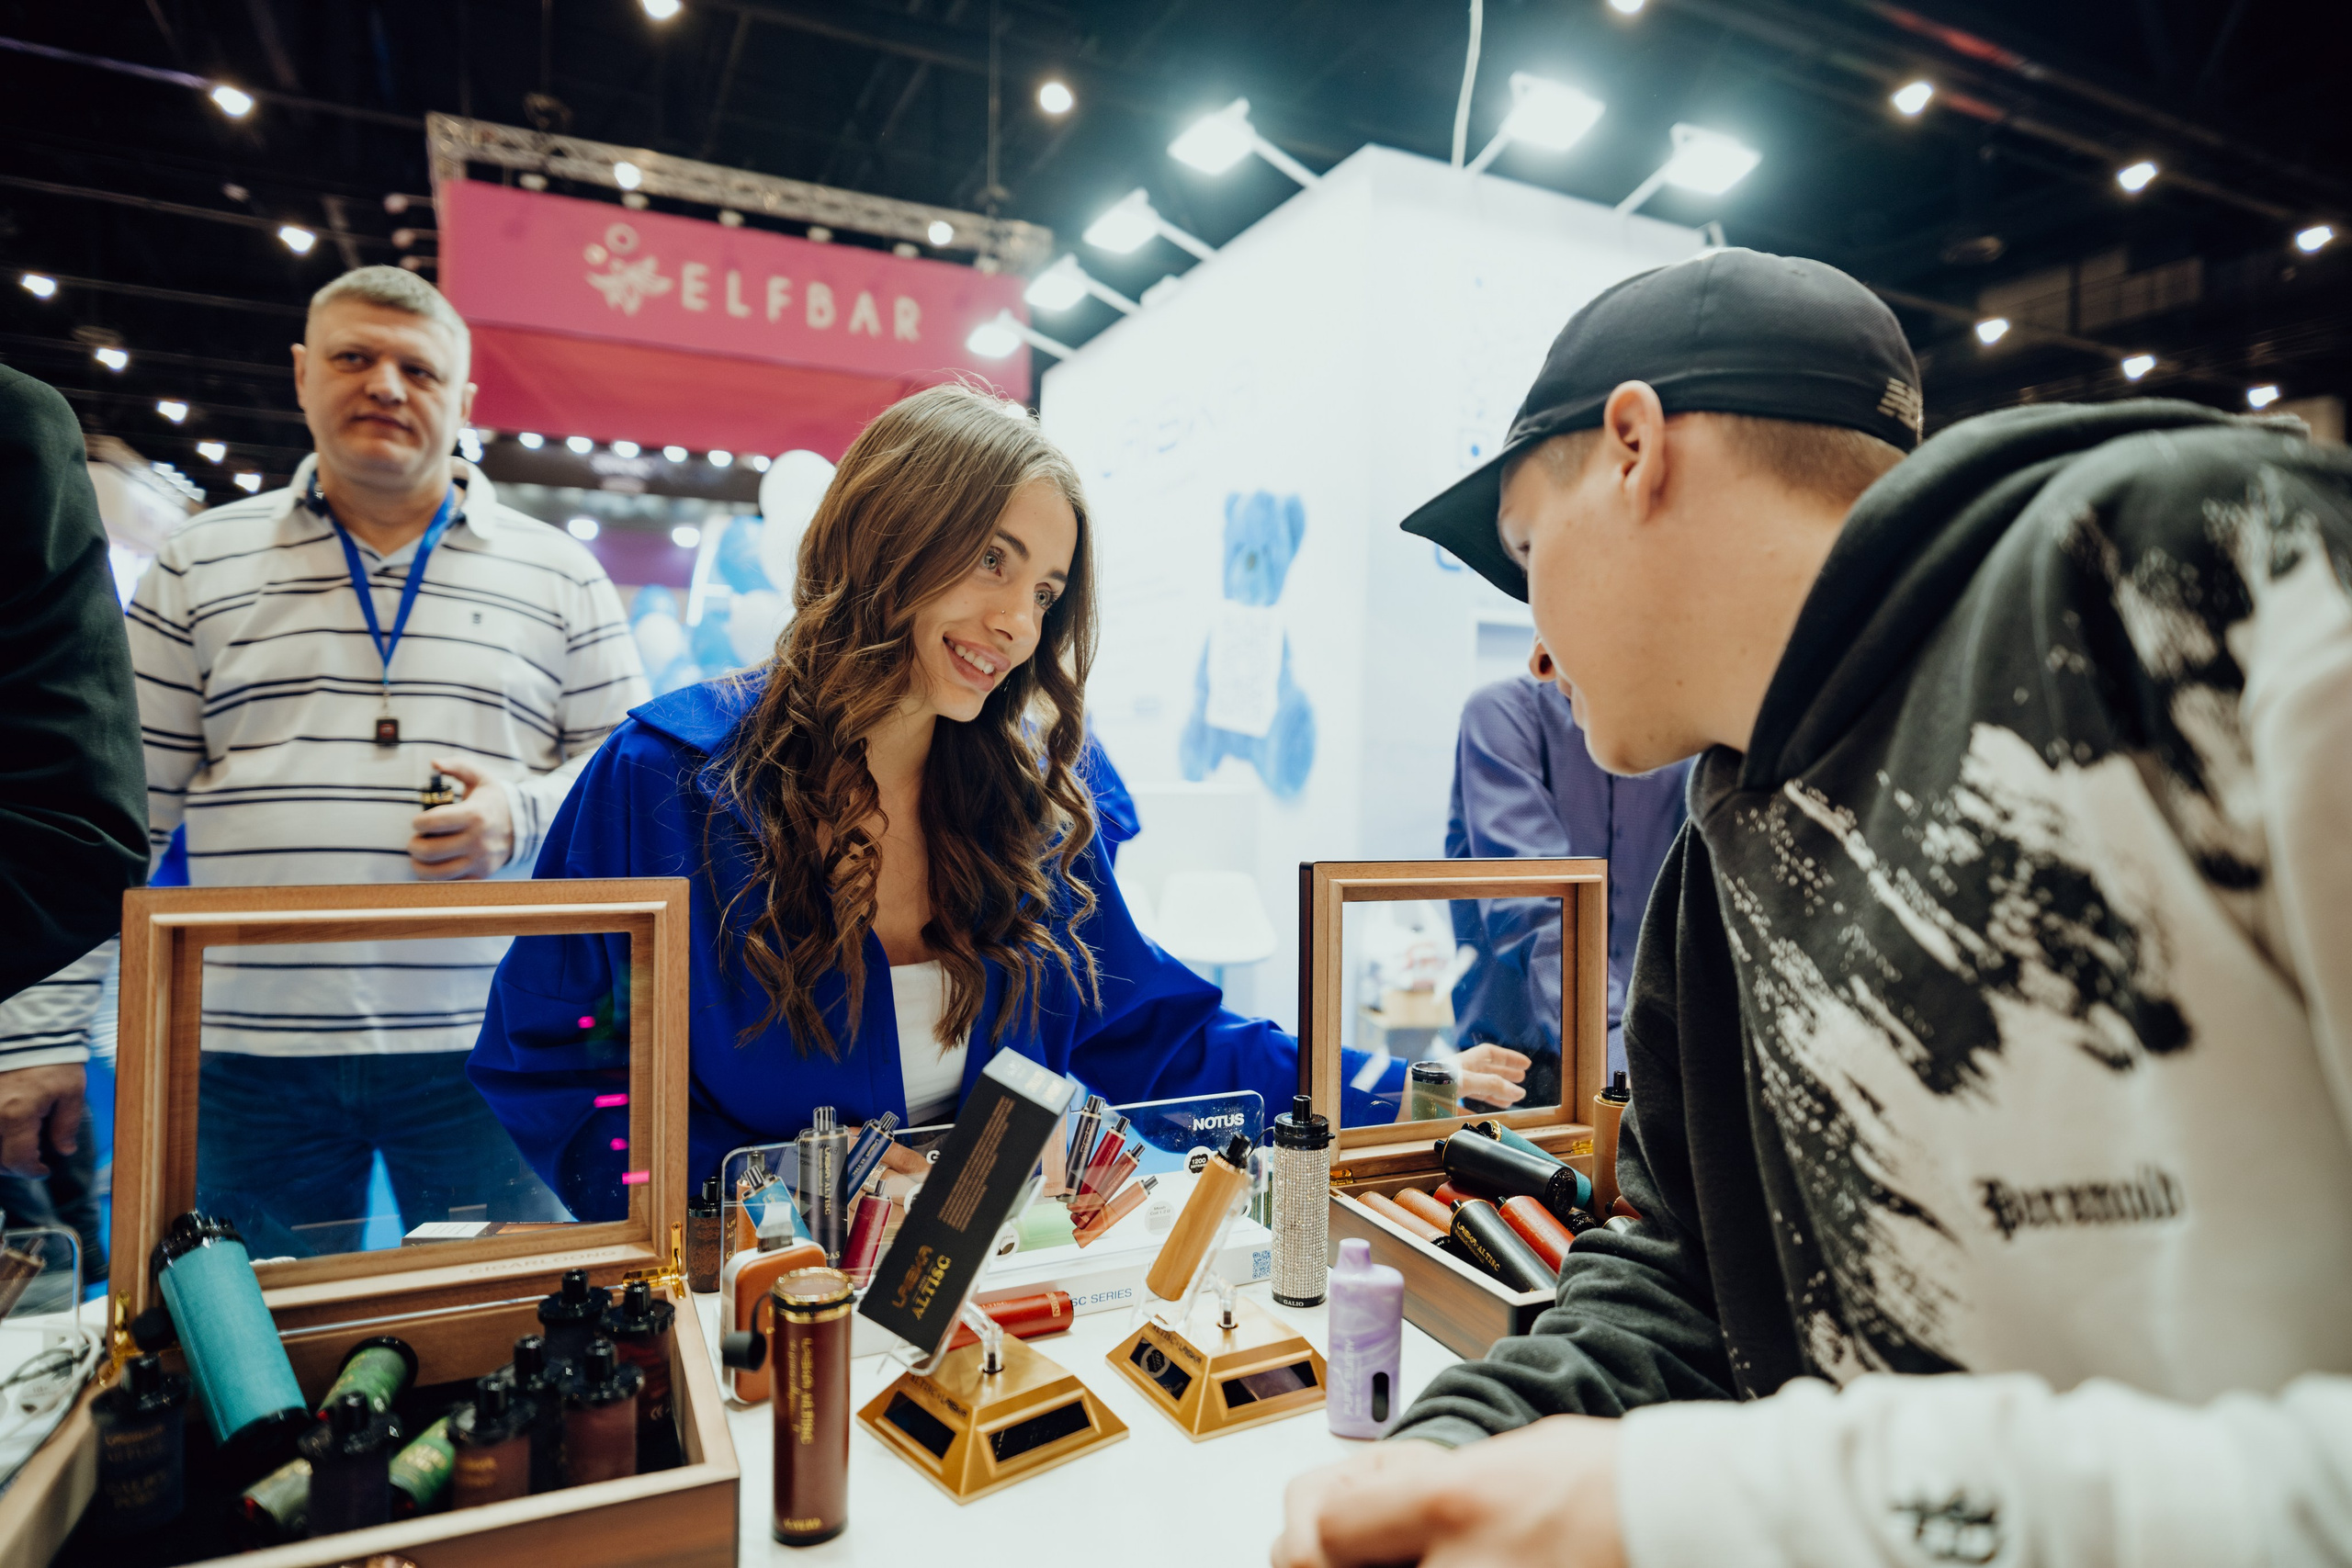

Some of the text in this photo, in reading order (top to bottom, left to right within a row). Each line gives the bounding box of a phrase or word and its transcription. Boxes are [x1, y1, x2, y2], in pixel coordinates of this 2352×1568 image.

[1193, 1112, 1245, 1131] NOTUS
[1478, 1245, 1500, 1272] ALTISC
[910, 1254, 953, 1321] ALTISC
[1091, 1288, 1133, 1303] SERIES
[1283, 1299, 1305, 1307] GALIO
